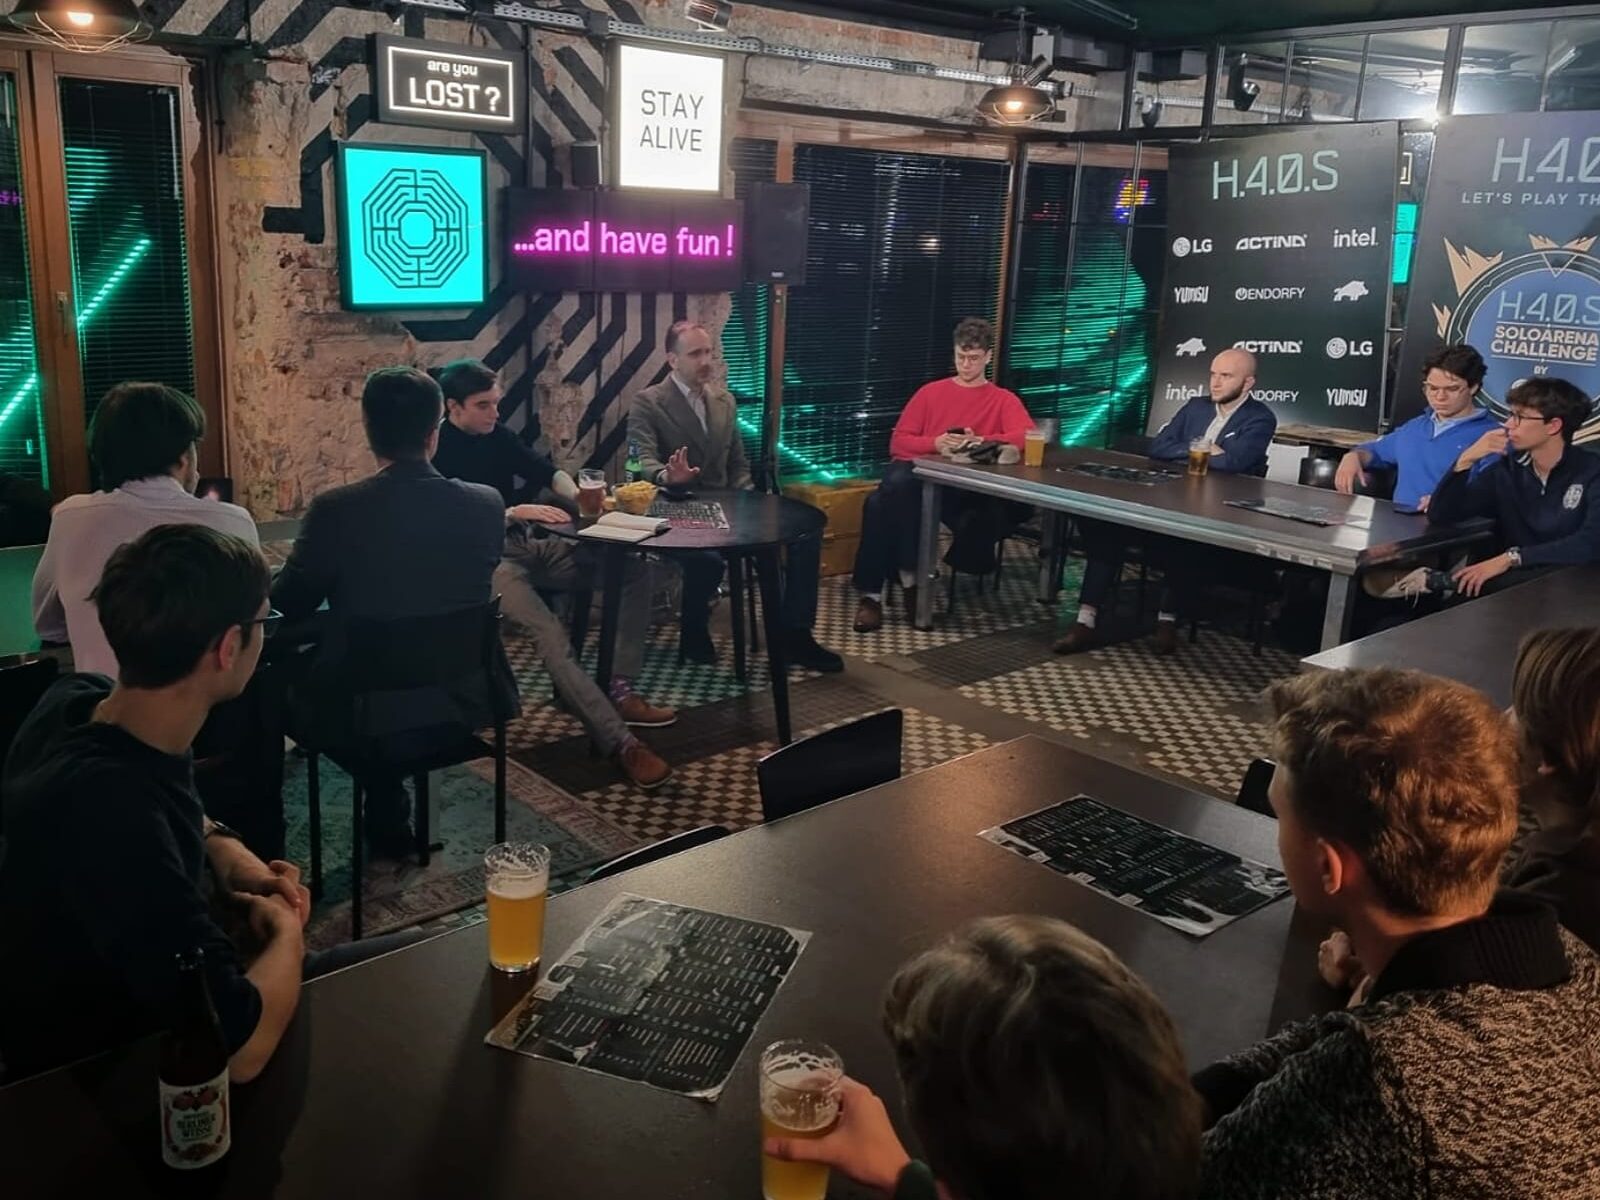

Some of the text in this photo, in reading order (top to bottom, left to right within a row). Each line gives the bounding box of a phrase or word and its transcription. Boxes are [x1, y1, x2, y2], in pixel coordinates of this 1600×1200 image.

[427, 58, 478, 78] are you
[409, 77, 480, 110] LOST
[640, 89, 704, 120] STAY
[639, 125, 703, 152] ALIVE
[1461, 192, 1512, 204] LET'S
[1520, 192, 1569, 205] PLAY
[600, 222, 667, 255] have
[676, 226, 721, 256] fun
[1192, 239, 1213, 252] LG
[1248, 287, 1305, 300] ENDORFY
[1495, 325, 1599, 346] SOLOARENA
[1350, 341, 1373, 355] LG
[1490, 340, 1598, 361] CHALLENGE
[1533, 365, 1548, 375] BY
